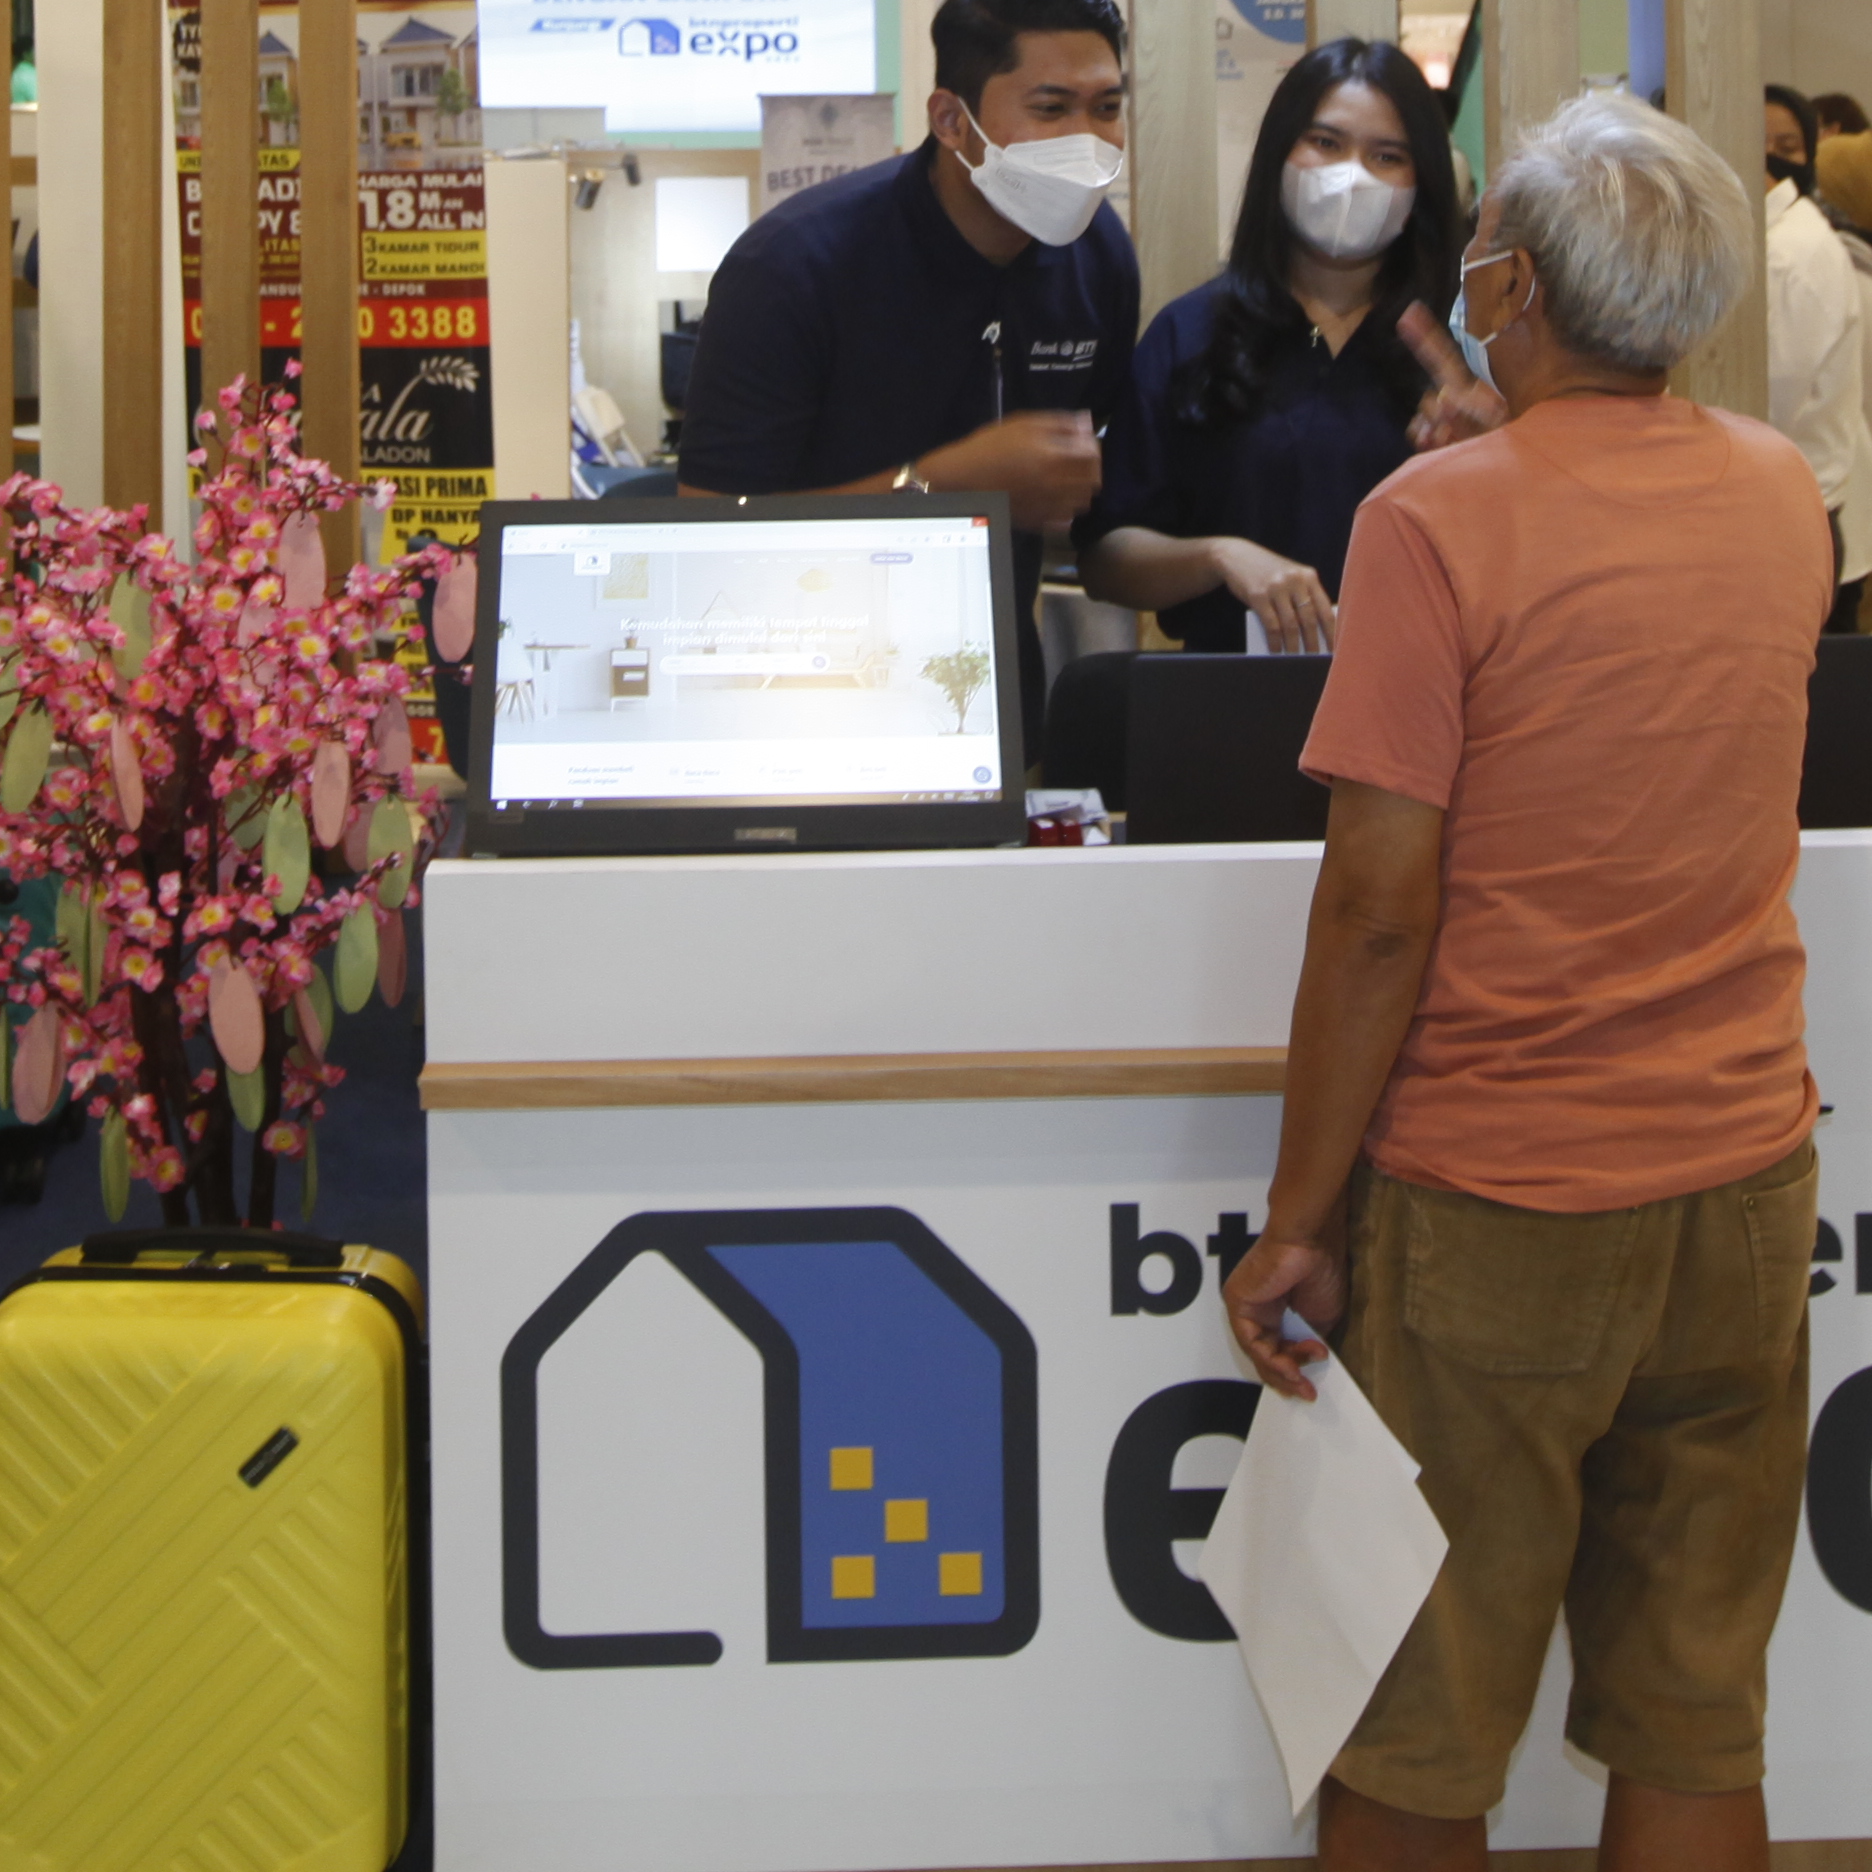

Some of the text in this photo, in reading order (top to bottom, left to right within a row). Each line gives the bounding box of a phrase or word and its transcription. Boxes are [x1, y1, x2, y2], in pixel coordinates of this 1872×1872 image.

[690, 31, 799, 63] expo
[422, 172, 484, 188] MULAI
[767, 166, 814, 191] BEST
[359, 189, 416, 232] 1,8
[417, 211, 485, 230] ALL IN
[364, 237, 480, 253] 3 KAMAR TIDUR
[366, 259, 486, 275] 2 KAMAR MANDI
[382, 283, 425, 296] DEPOK
[388, 306, 478, 339] 3388
[426, 475, 487, 497] PRIMA
[392, 507, 416, 524] DP
